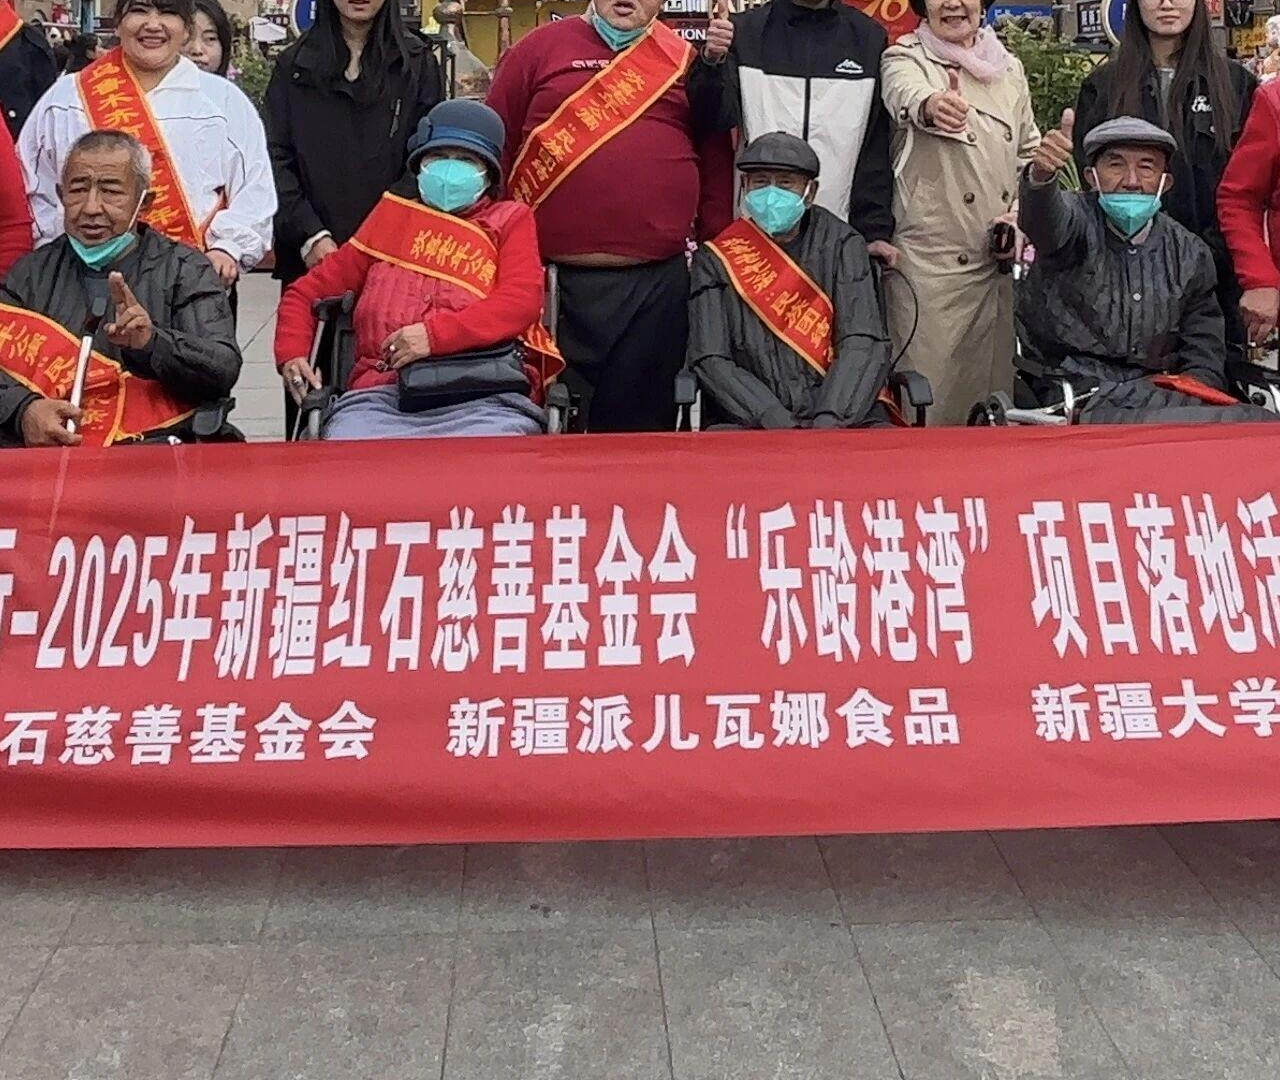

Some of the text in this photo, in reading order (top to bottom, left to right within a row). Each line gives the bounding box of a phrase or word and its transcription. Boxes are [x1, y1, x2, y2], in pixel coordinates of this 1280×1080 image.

[675, 28, 706, 40] TION
[446, 687, 961, 758] 新疆派儿瓦娜食品
